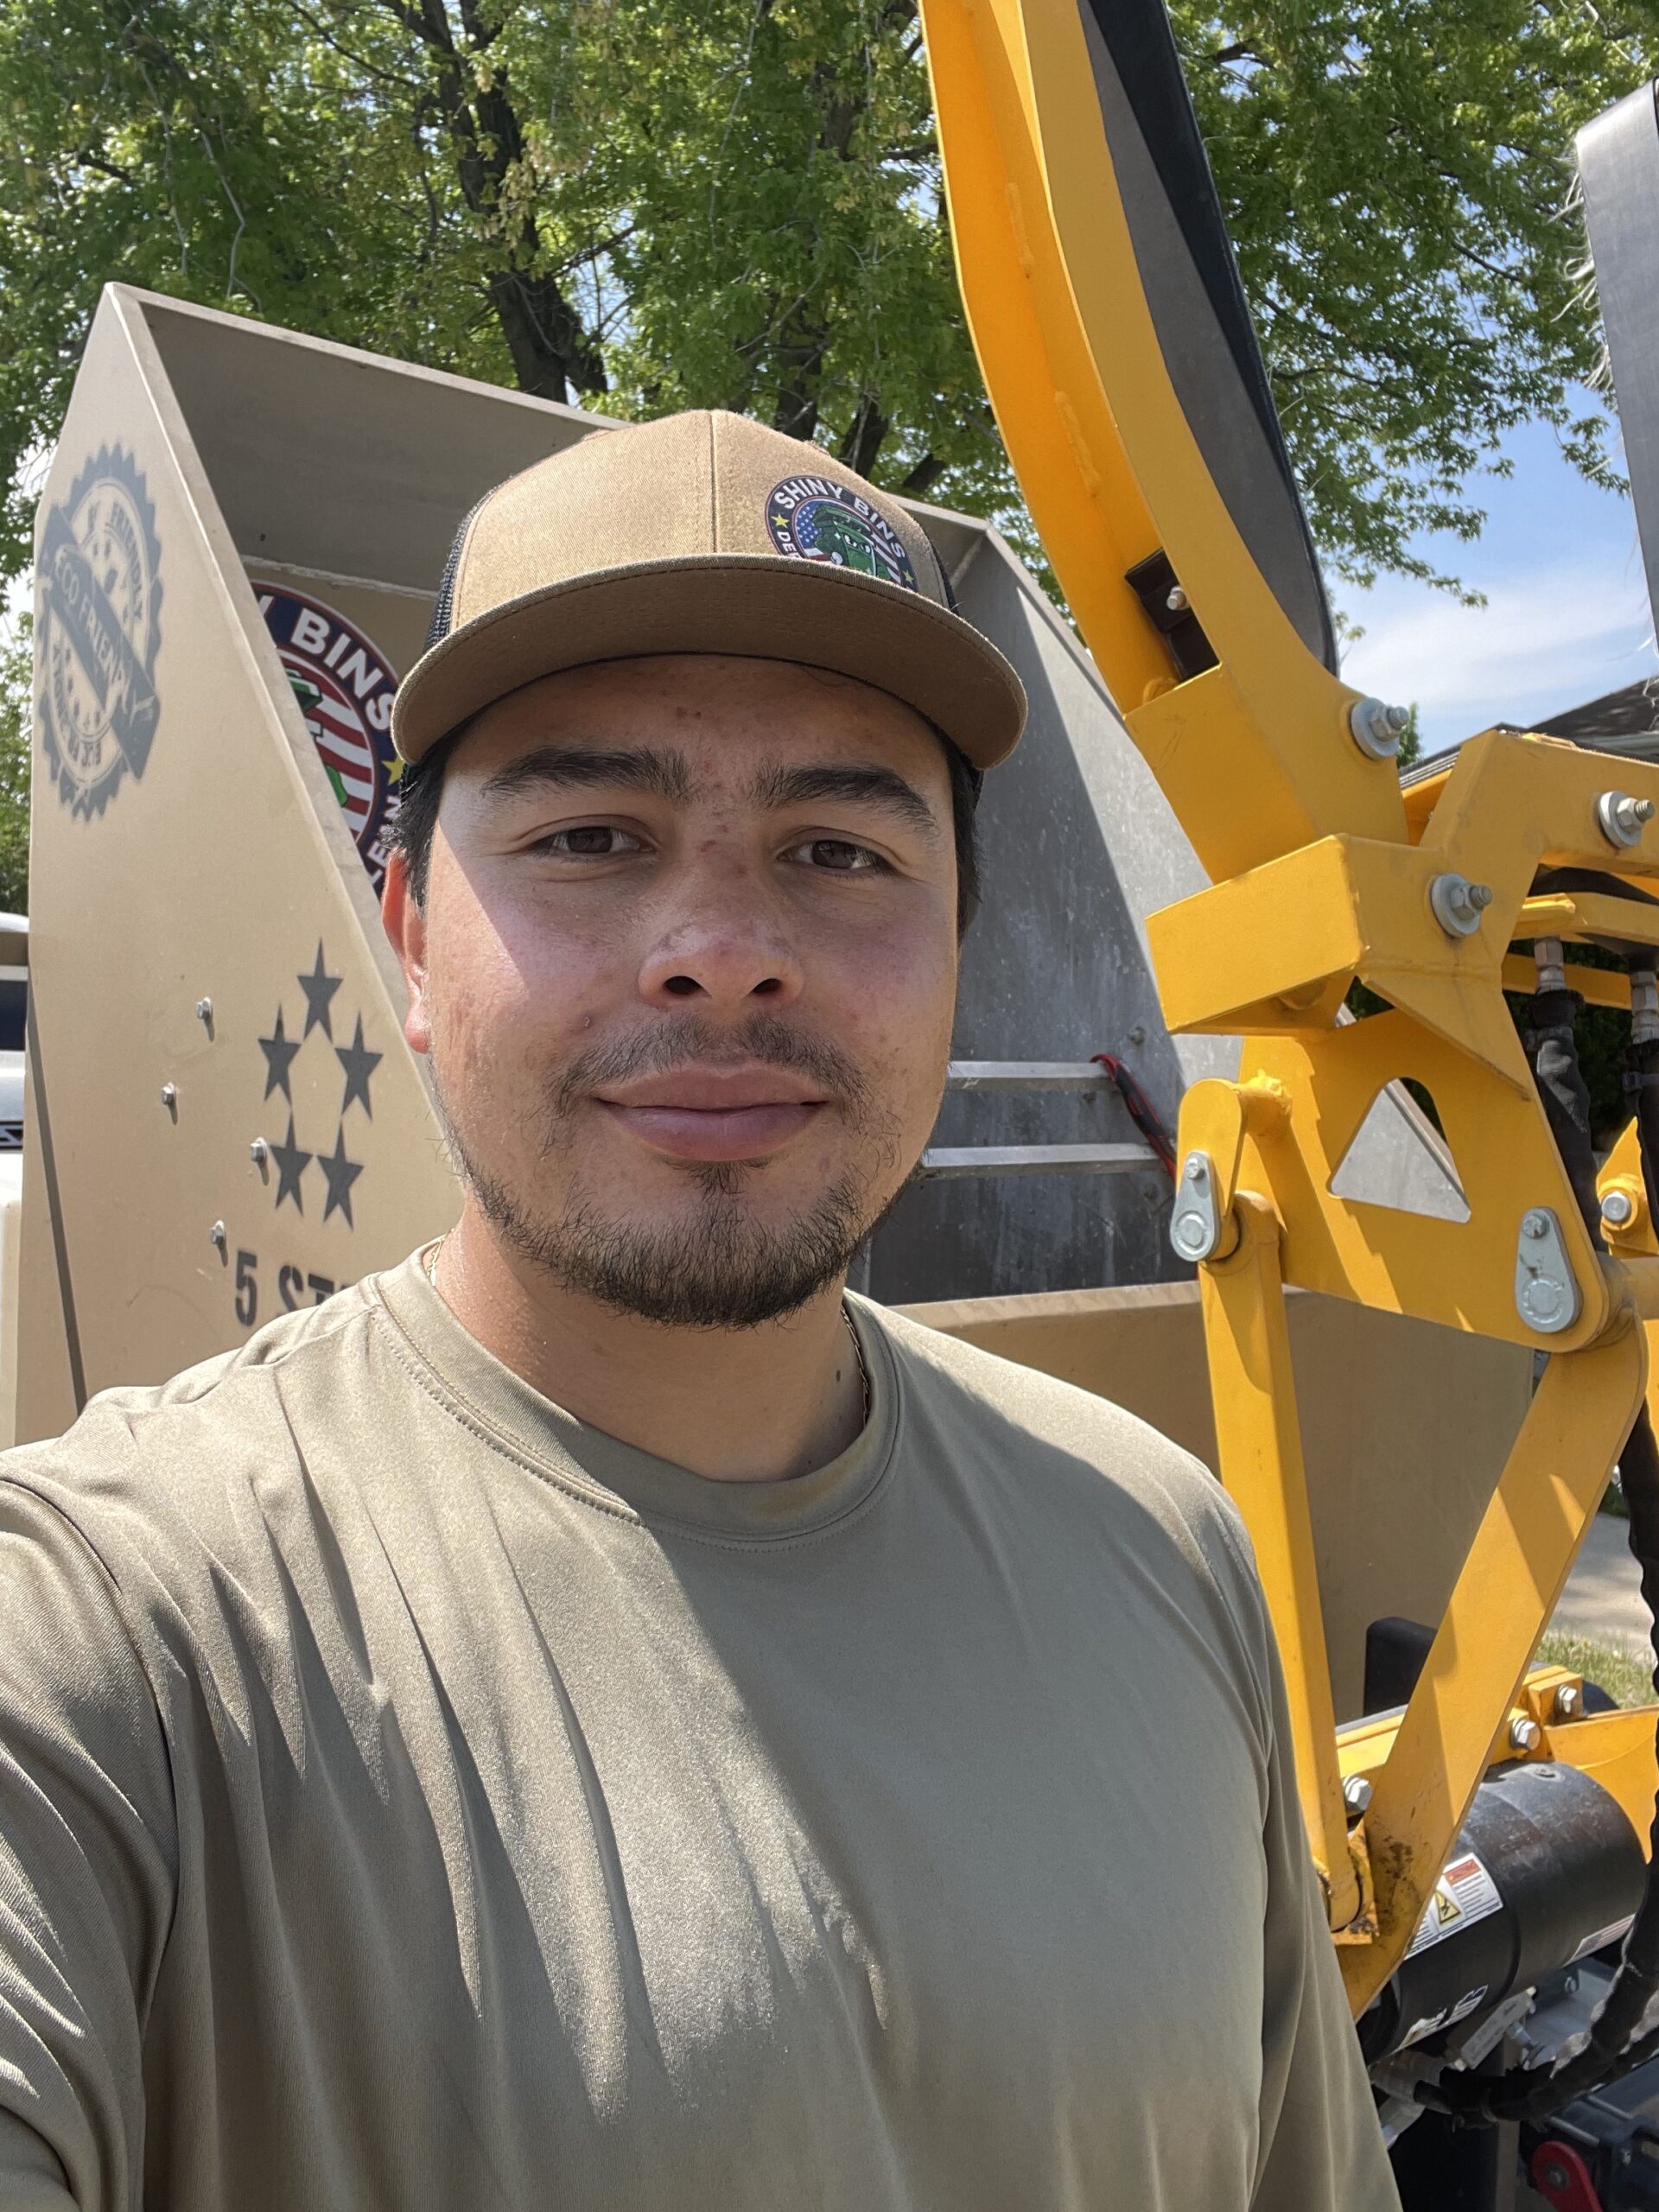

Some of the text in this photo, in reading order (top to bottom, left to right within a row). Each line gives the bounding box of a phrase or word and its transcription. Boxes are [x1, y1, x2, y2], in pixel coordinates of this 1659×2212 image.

[773, 478, 906, 558] SHINY BINS
[290, 607, 395, 731] BINS
[235, 1249, 351, 1326] 5 ST
